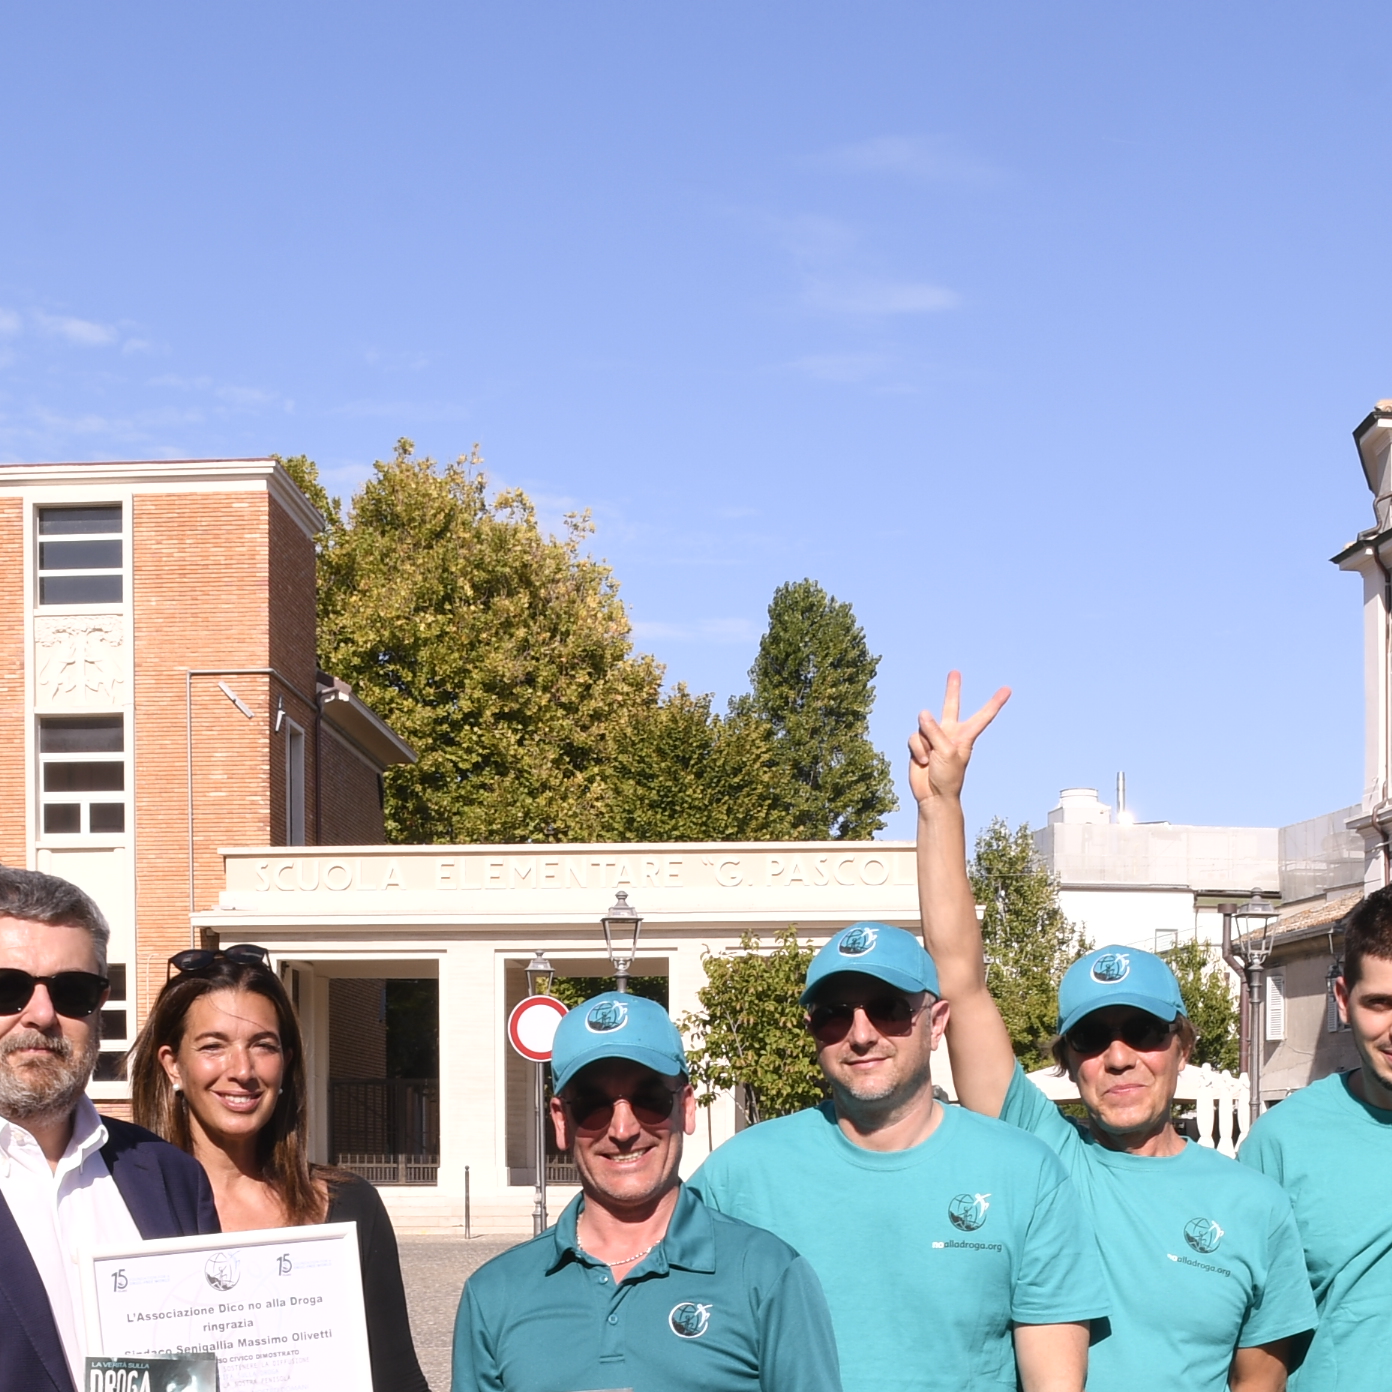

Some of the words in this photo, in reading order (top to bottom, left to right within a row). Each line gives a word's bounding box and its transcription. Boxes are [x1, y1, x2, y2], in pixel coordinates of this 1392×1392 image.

[256, 860, 407, 892] SCUOLA
[436, 858, 684, 890] ELEMENTARE
[932, 1240, 1002, 1253] noalladroga.org
[276, 1253, 292, 1276] 15
[1167, 1253, 1232, 1278] noalladroga.org
[111, 1269, 128, 1292] 15
[127, 1306, 215, 1322] L'Associazione
[218, 1303, 244, 1314] Dico
[248, 1301, 262, 1310] no
[266, 1298, 286, 1308] alla
[290, 1296, 323, 1306] Droga
[203, 1318, 254, 1332] ringrazia
[176, 1340, 234, 1354] Senigallia
[237, 1335, 288, 1348] Massimo
[292, 1328, 332, 1342] Olivetti
[256, 1350, 300, 1359] DIMOSTRATO
